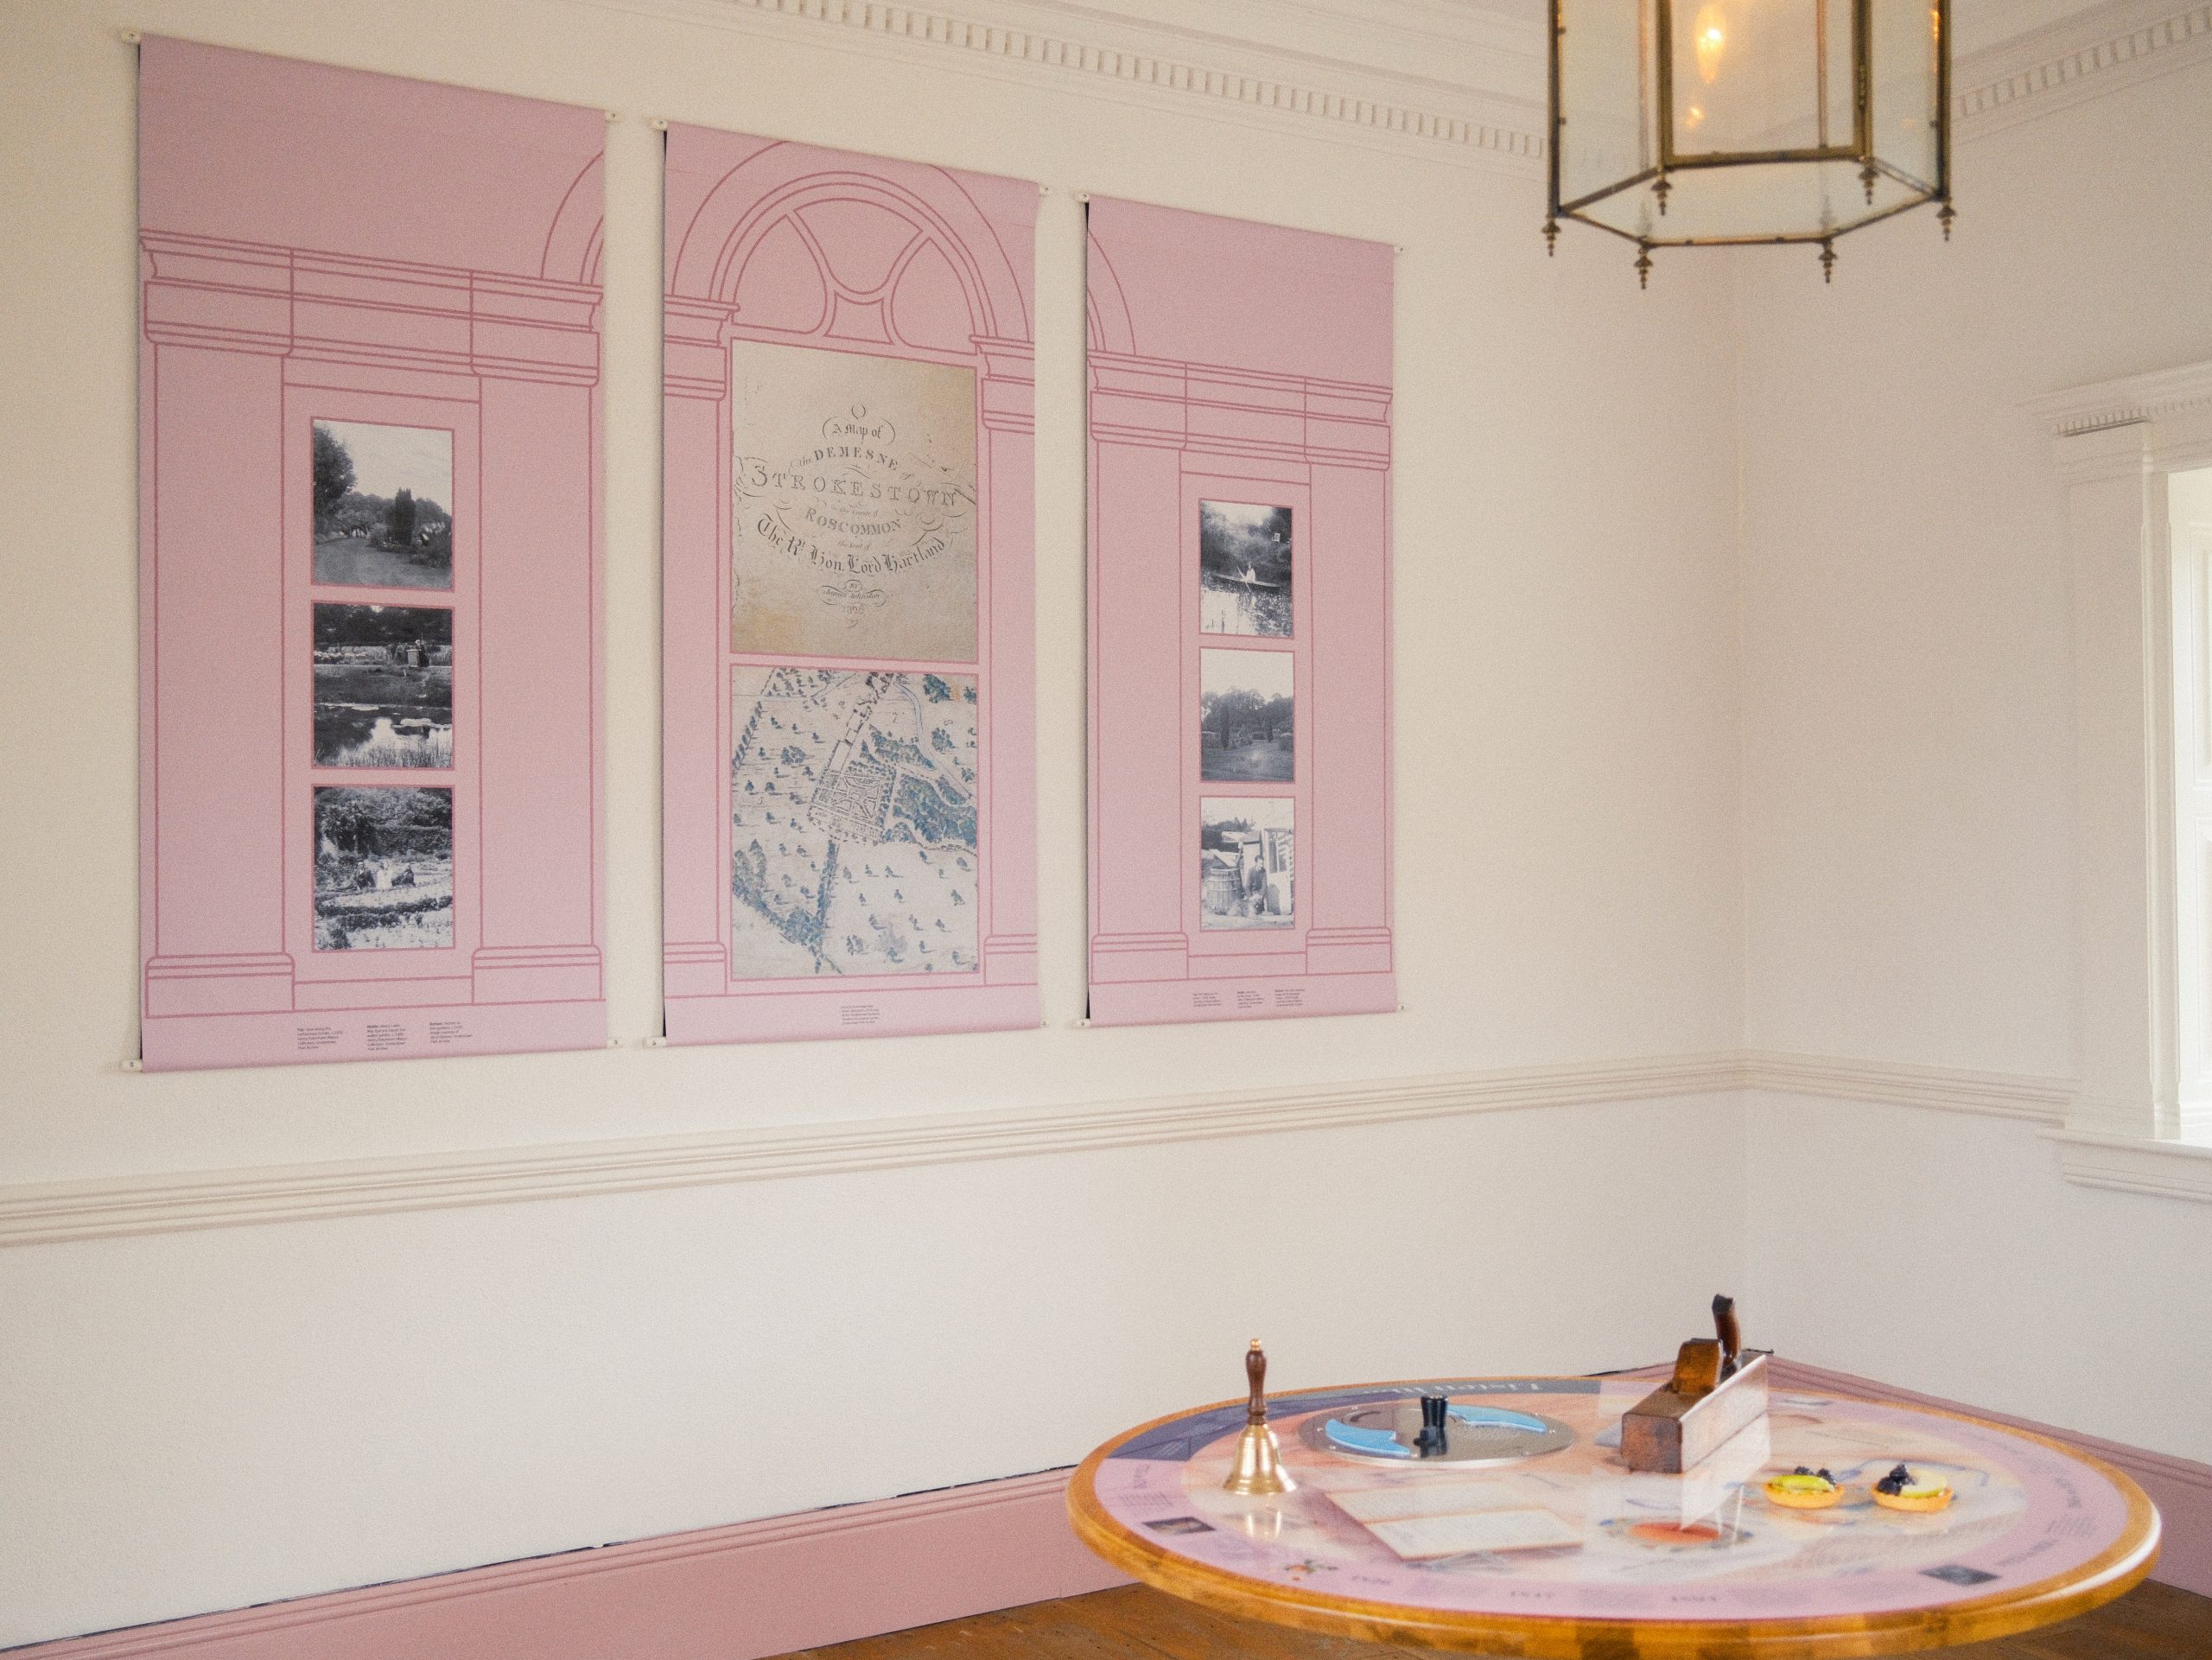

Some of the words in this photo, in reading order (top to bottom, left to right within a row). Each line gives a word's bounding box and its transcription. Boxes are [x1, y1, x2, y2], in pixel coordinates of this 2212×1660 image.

[845, 423, 868, 445] Map
[871, 424, 884, 439] of
[814, 446, 898, 470] DEMESNE
[752, 465, 957, 506] STROKESTOWN
[805, 506, 902, 535] ROSCOMMON
[758, 512, 784, 545] The
[848, 554, 881, 574] Lord
[881, 537, 944, 572] Hartland
